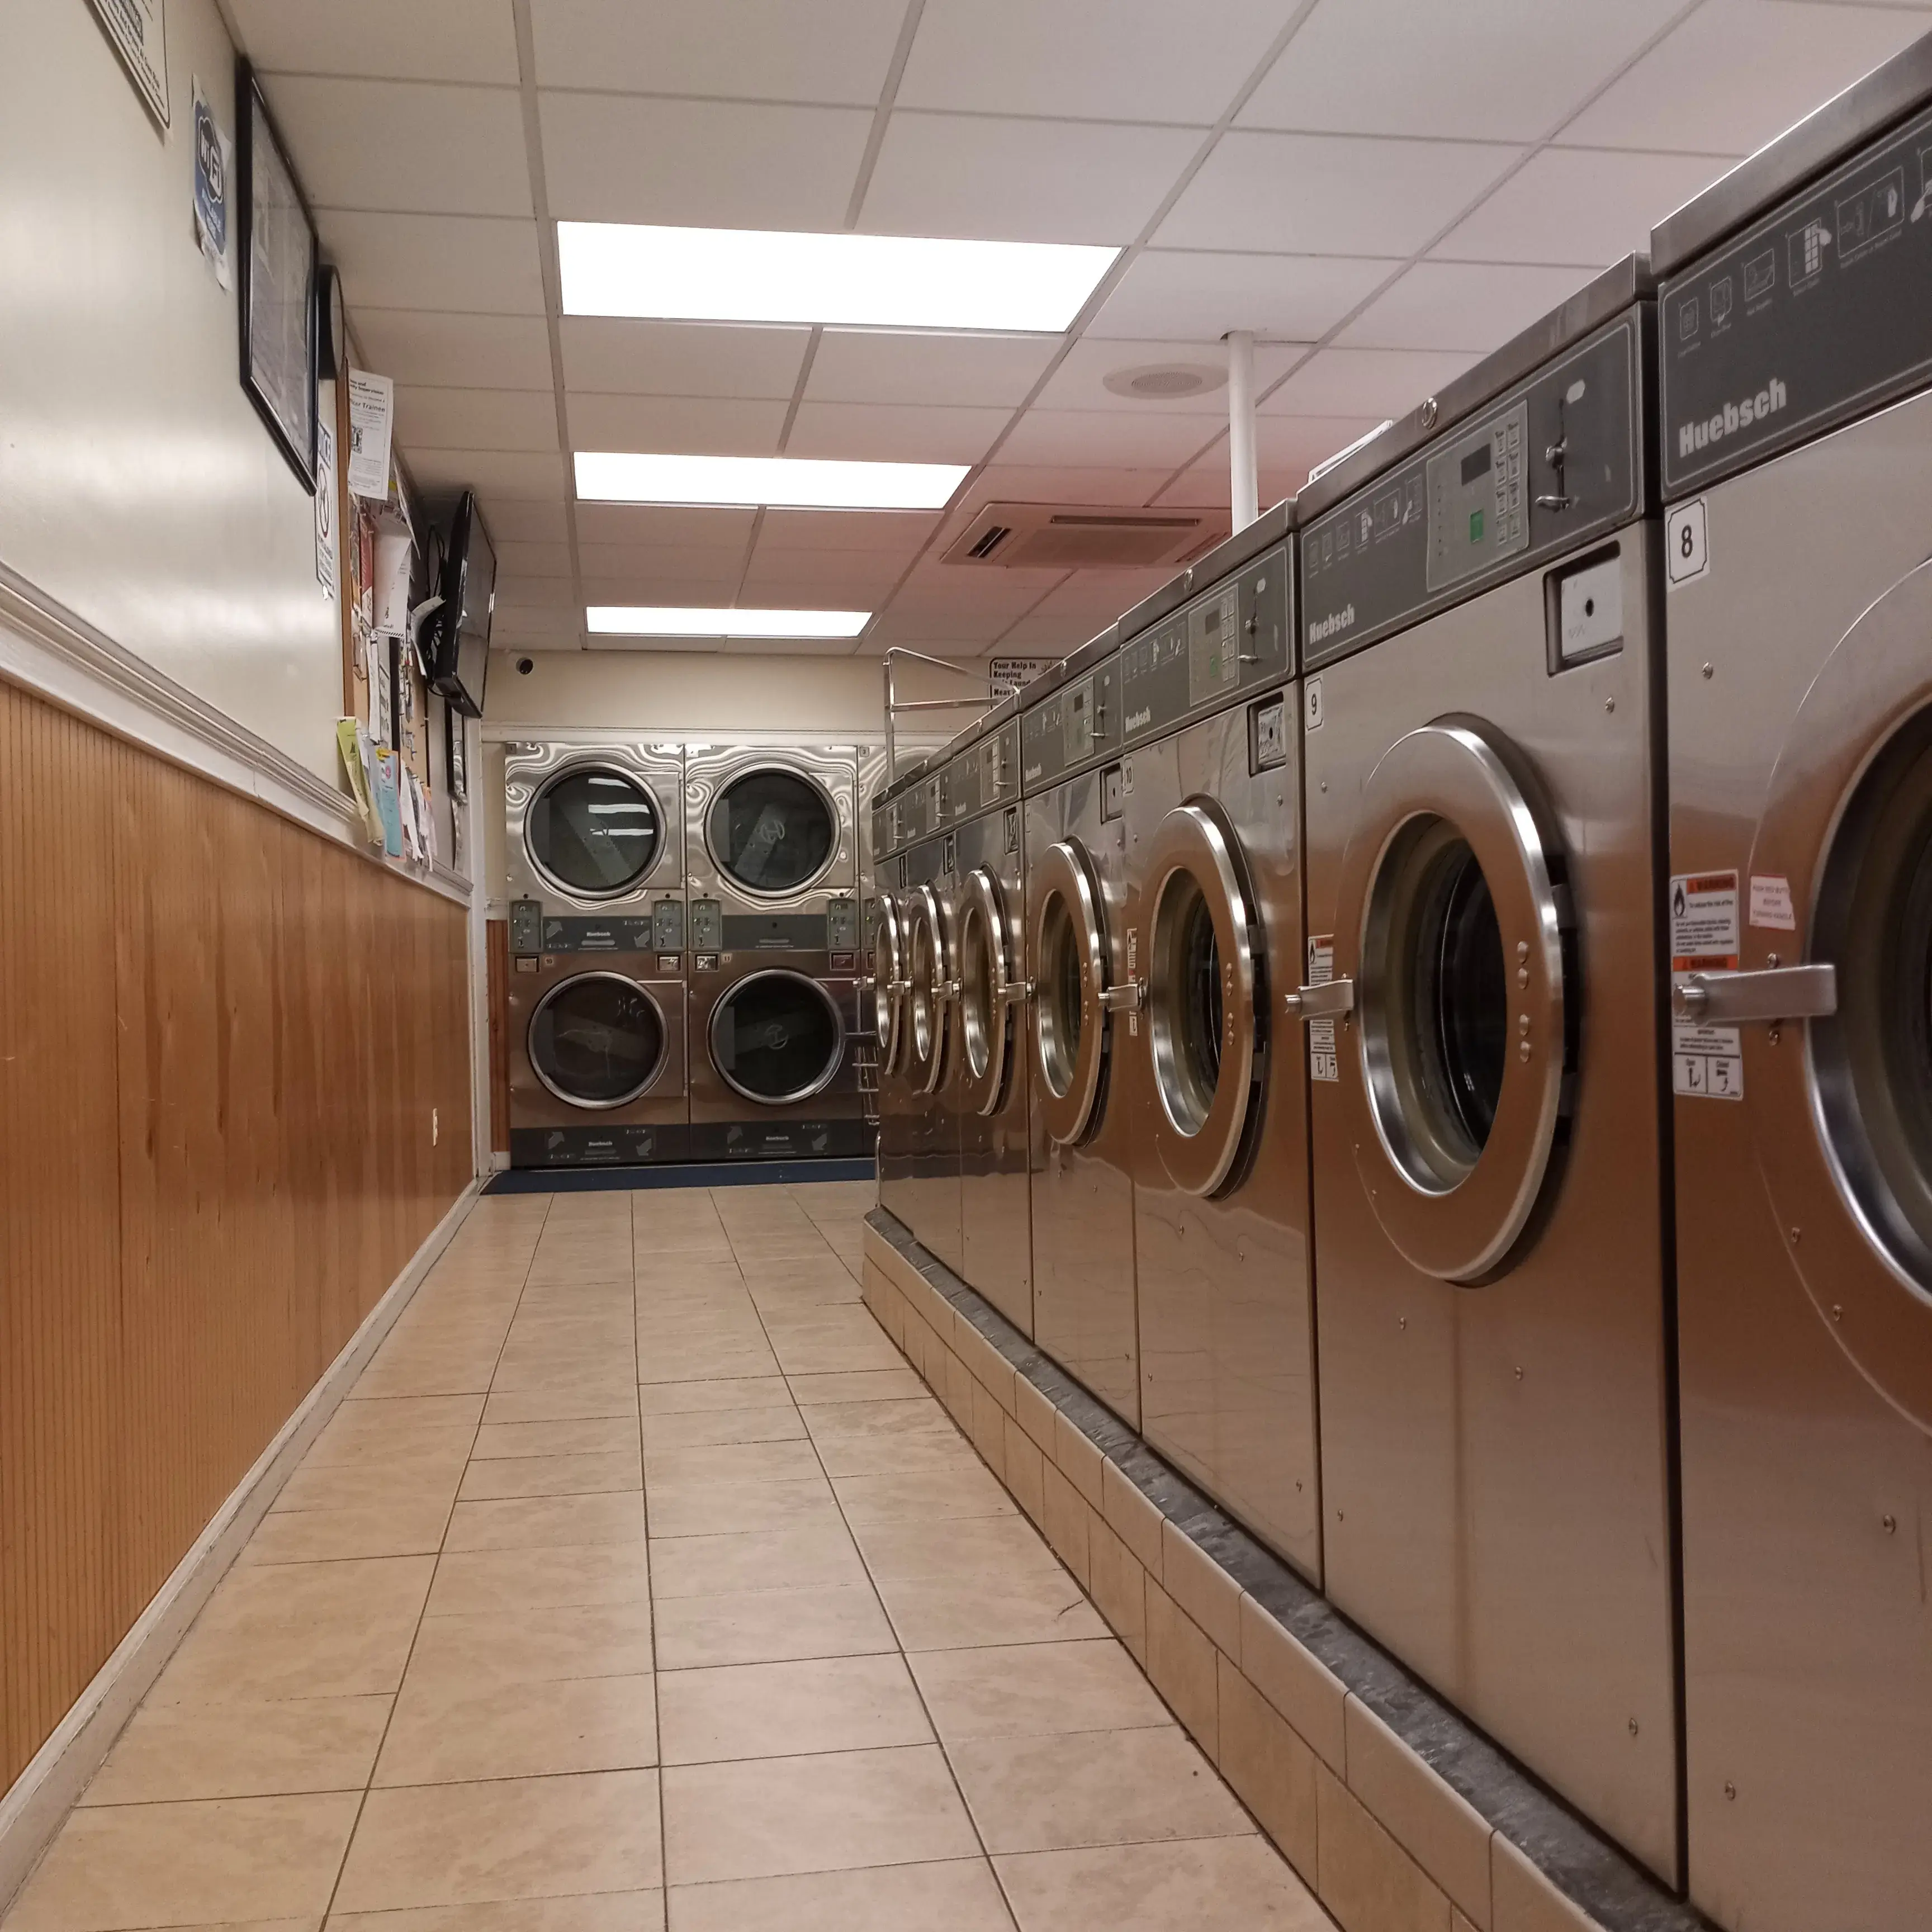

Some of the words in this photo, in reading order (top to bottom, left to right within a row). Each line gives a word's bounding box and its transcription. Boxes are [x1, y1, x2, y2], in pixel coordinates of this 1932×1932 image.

[362, 402, 385, 413] Trainee
[1679, 377, 1787, 458] Huebsch
[1680, 524, 1694, 558] 8
[1310, 603, 1354, 644] Huebsch
[993, 670, 1022, 679] Keeping
[1011, 662, 1027, 670] Help
[1311, 693, 1317, 716] 9
[1125, 706, 1150, 733] Huebsch
[1126, 766, 1132, 784] 10
